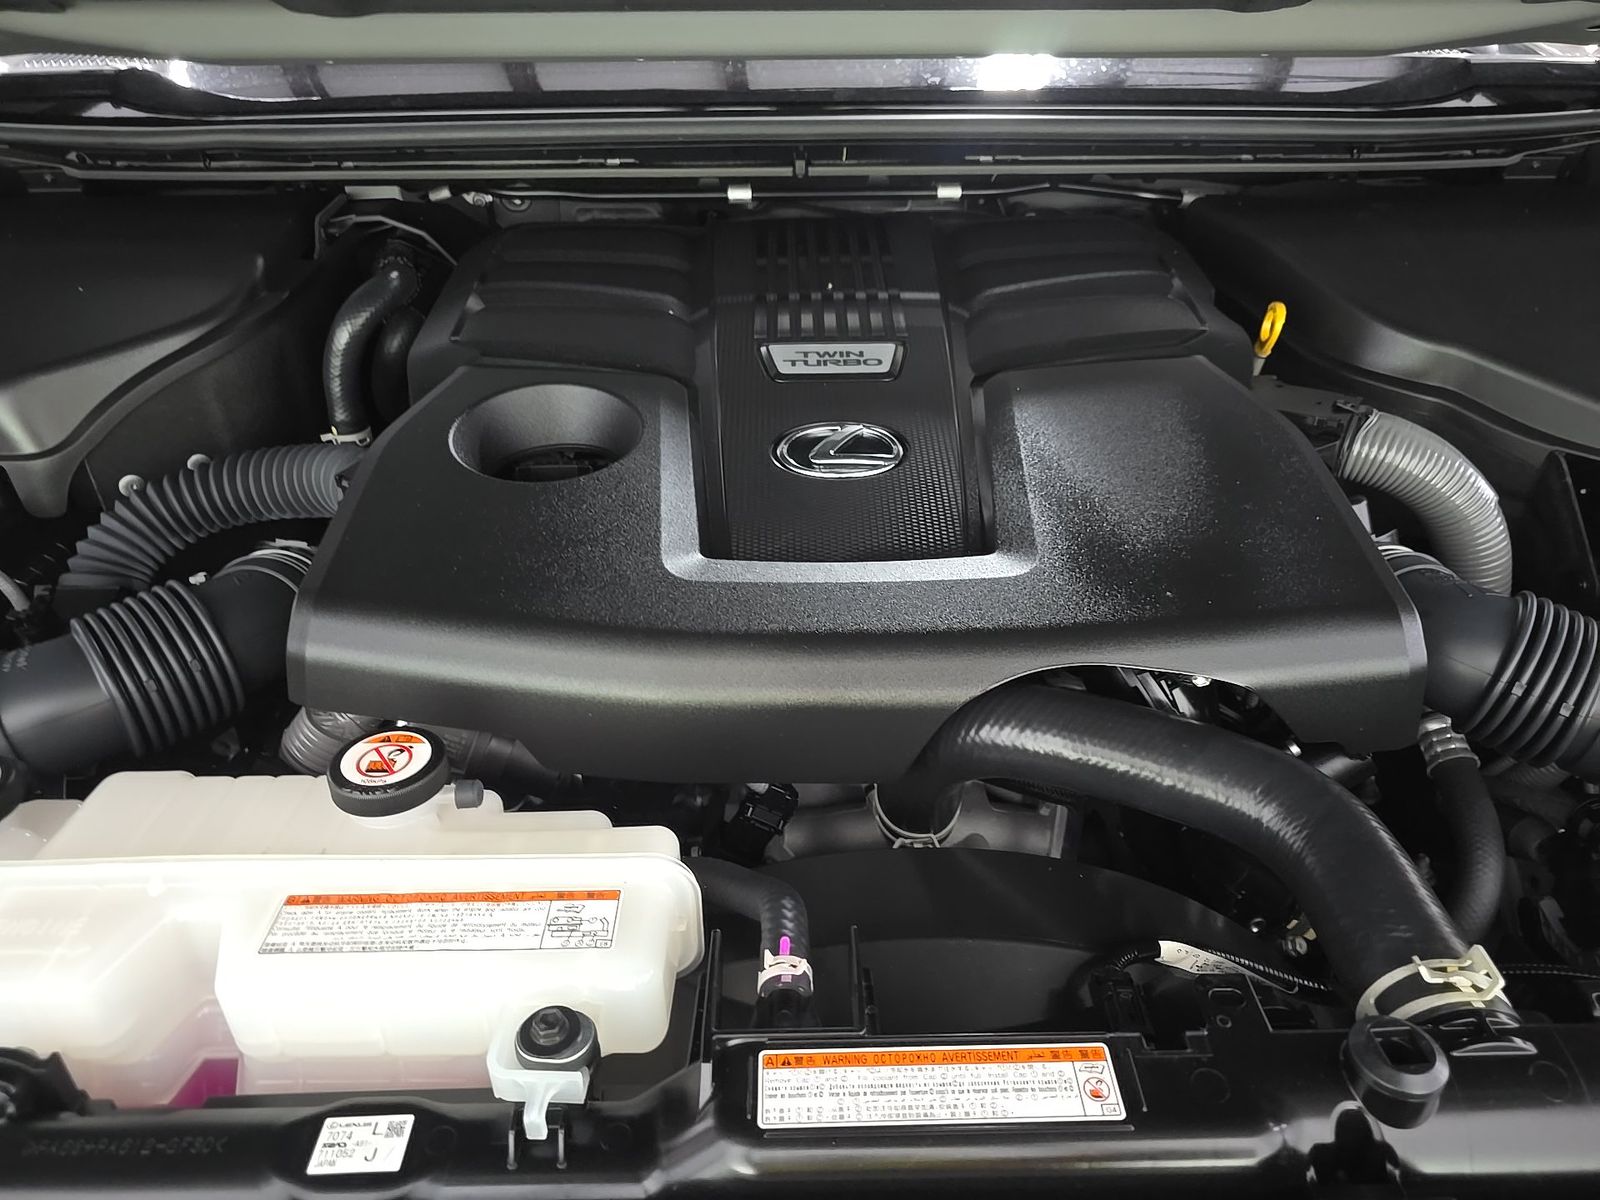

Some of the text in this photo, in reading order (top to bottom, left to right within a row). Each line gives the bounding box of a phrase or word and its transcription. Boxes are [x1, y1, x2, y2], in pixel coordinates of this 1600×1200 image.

[794, 350, 864, 358] TWIN
[782, 358, 883, 367] TURBO
[765, 1056, 775, 1066] A
[822, 1054, 868, 1065] WARNING
[942, 1050, 1019, 1062] AVERTISSEMENT
[372, 1122, 384, 1135] L
[327, 1131, 353, 1141] 7074
[319, 1149, 355, 1158] 711052
[364, 1147, 377, 1161] J
